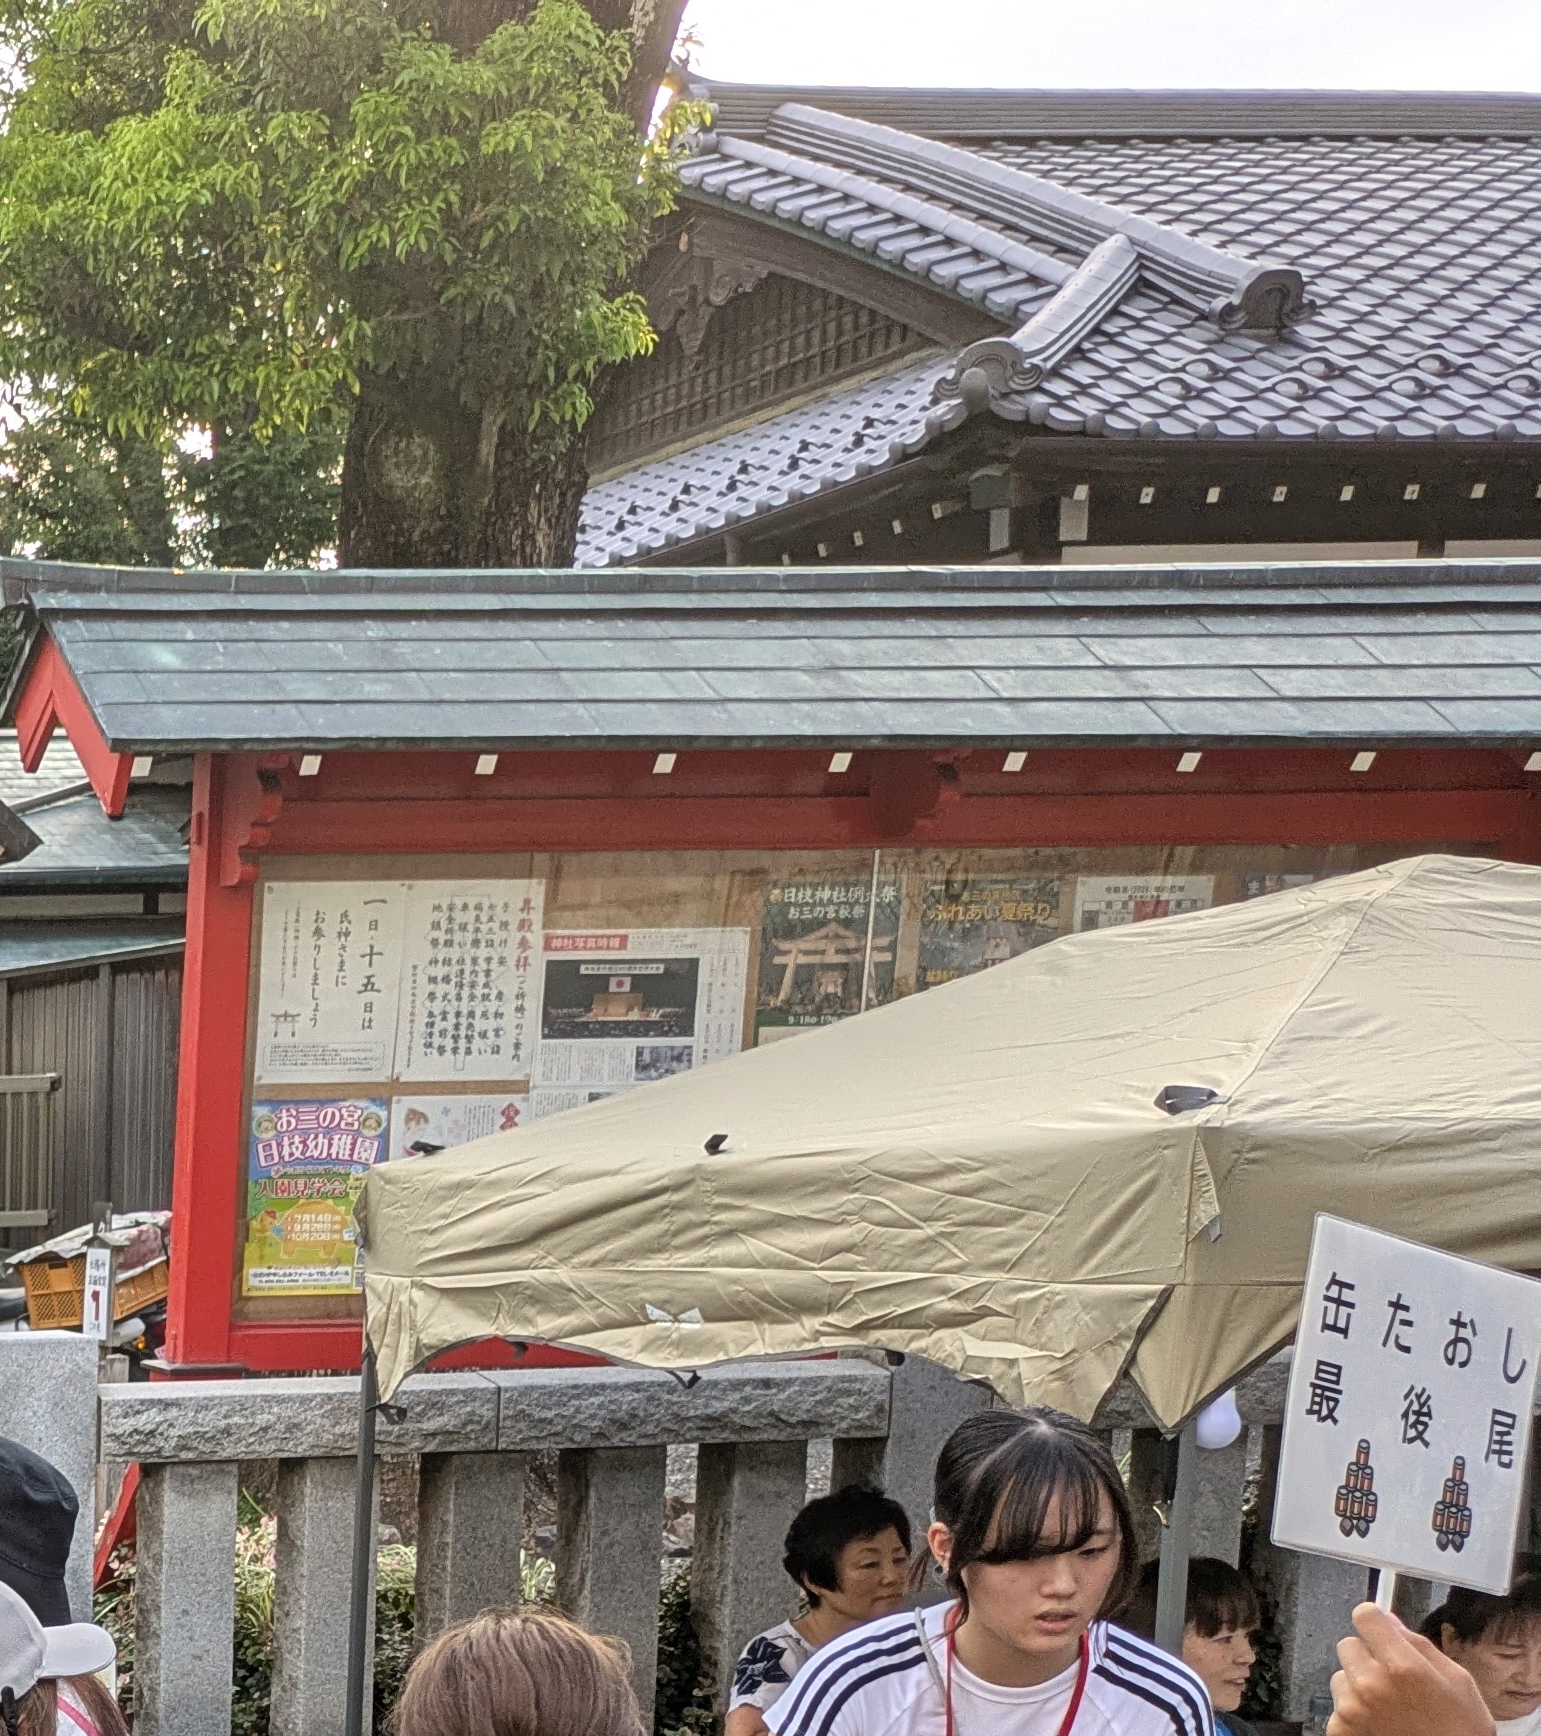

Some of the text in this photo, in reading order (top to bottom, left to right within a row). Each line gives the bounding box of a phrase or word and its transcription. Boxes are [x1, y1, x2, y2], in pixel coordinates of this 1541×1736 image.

[309, 910, 327, 1029] お参りしましょう
[336, 909, 352, 988] 氏神さまに
[257, 1132, 380, 1168] 日枝幼稚園
[276, 1105, 363, 1133] お三の宮
[259, 1177, 347, 1199] 入園見学会
[1320, 1271, 1527, 1384] 缶たおし
[1305, 1359, 1518, 1470] 最後尾
